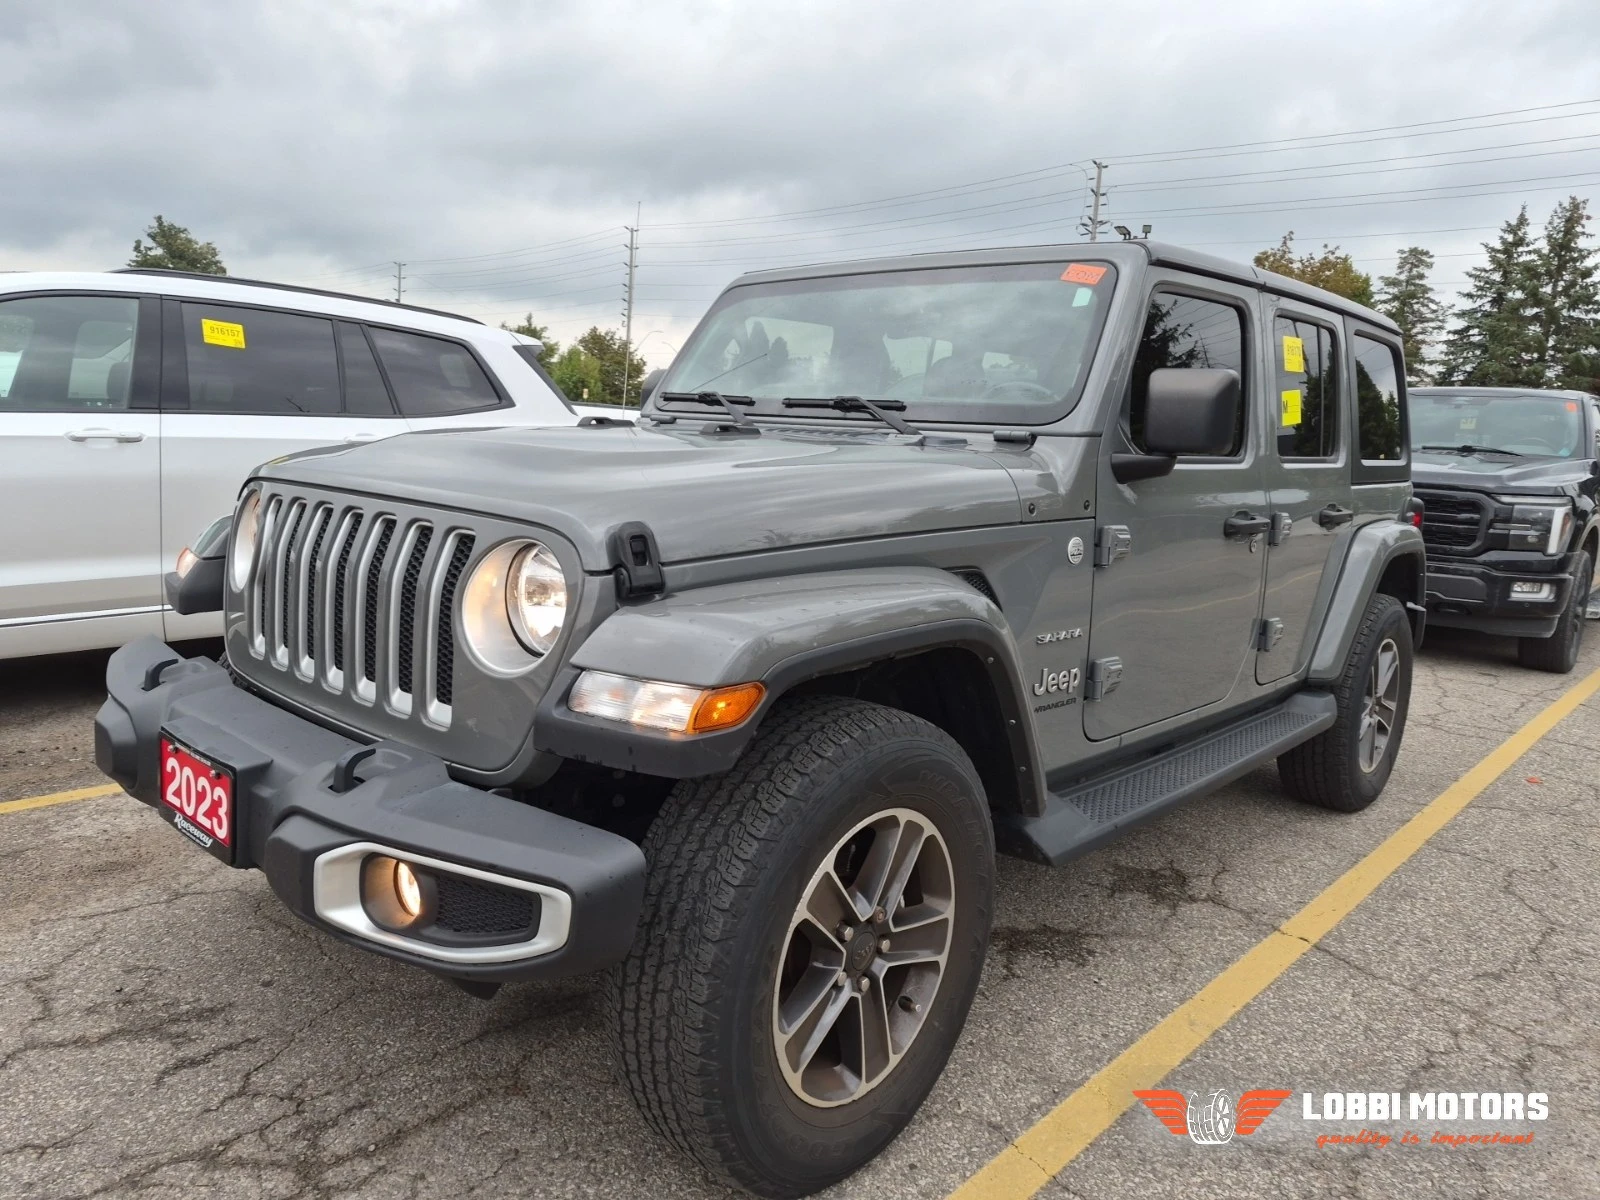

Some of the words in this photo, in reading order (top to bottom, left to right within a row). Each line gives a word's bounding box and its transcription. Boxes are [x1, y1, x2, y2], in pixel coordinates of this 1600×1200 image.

[1036, 628, 1083, 645] SAHARA
[1033, 667, 1081, 696] Jeep
[1034, 698, 1077, 713] WRANGLER
[166, 756, 228, 840] 2023
[174, 811, 213, 848] Raceway
